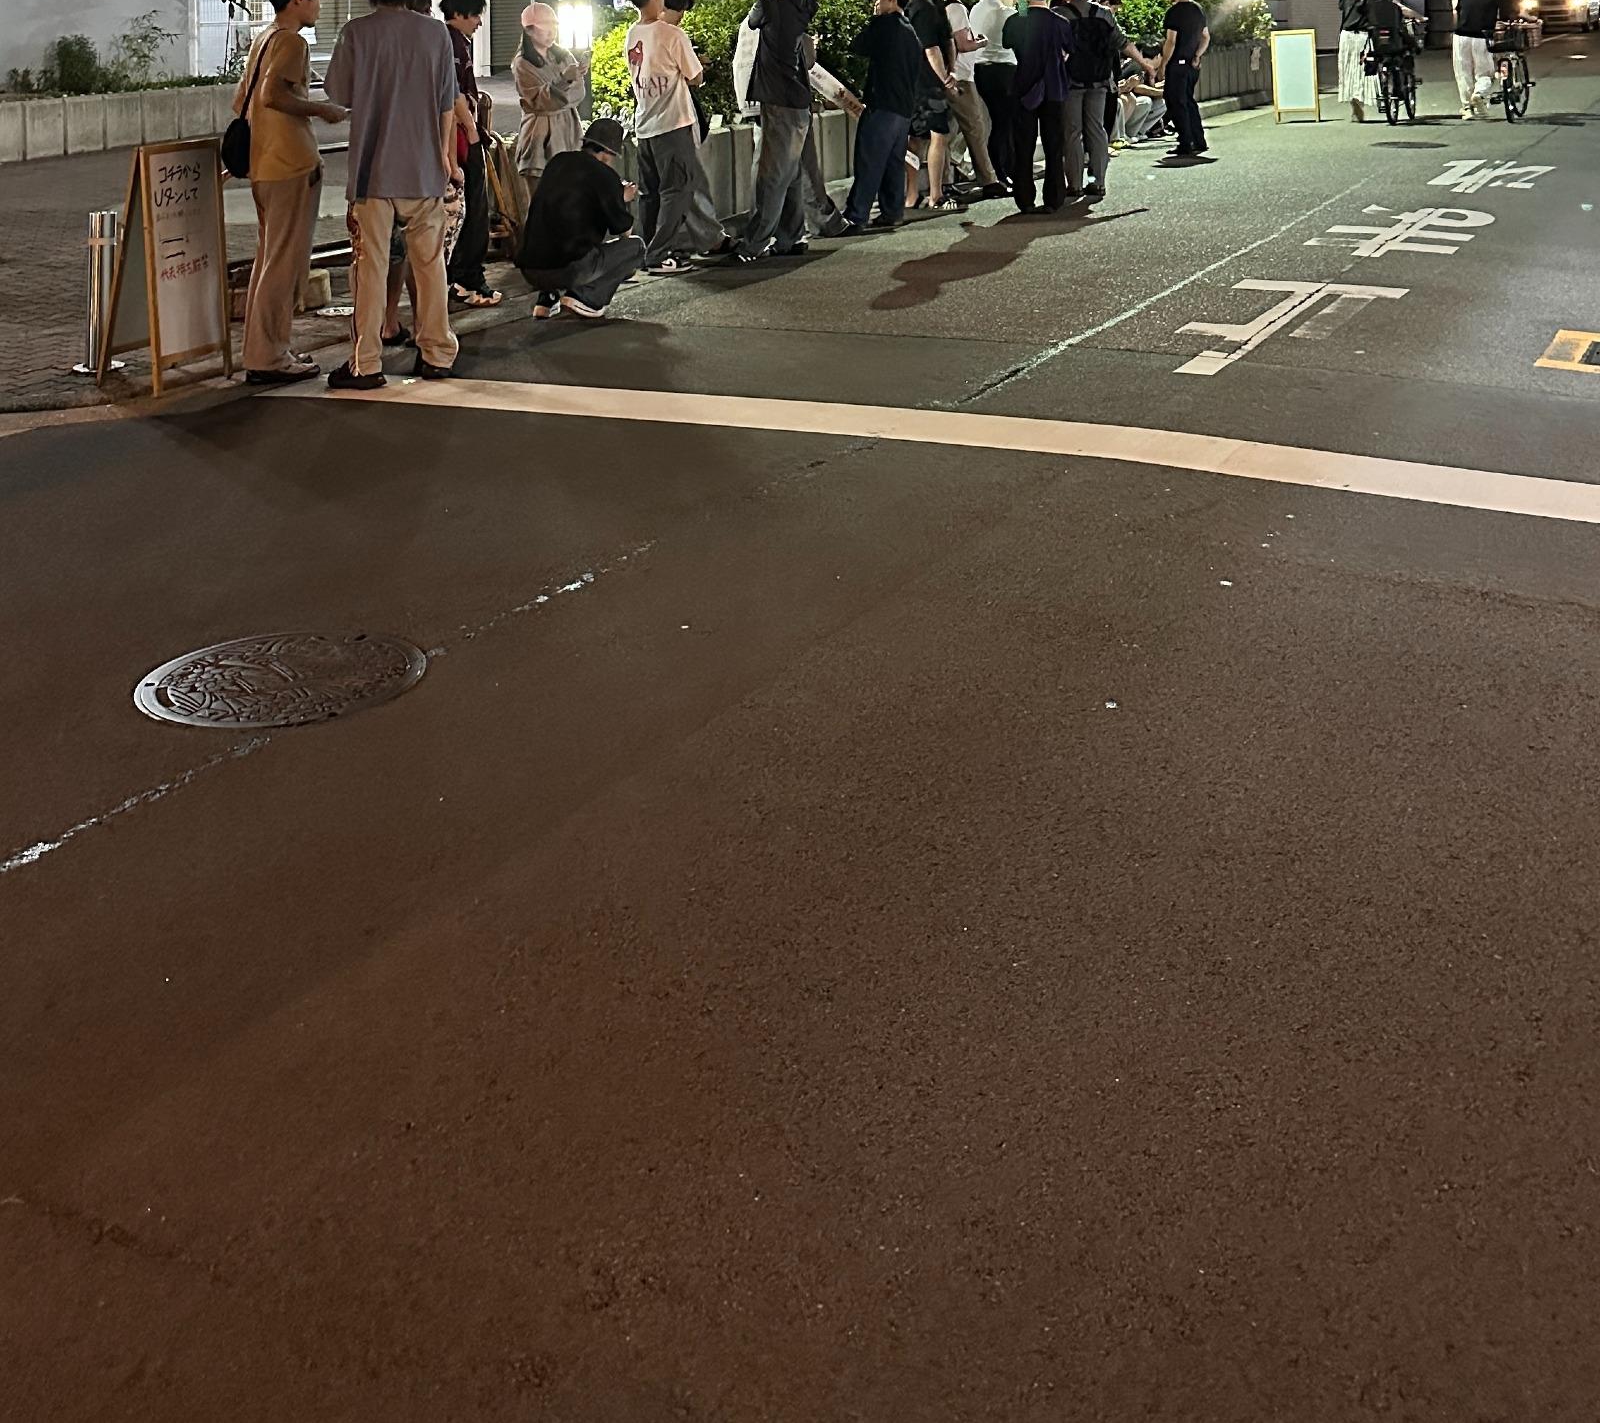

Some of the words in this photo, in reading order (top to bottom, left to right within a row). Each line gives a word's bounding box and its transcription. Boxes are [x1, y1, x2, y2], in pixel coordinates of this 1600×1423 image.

[158, 161, 201, 184] コチラから
